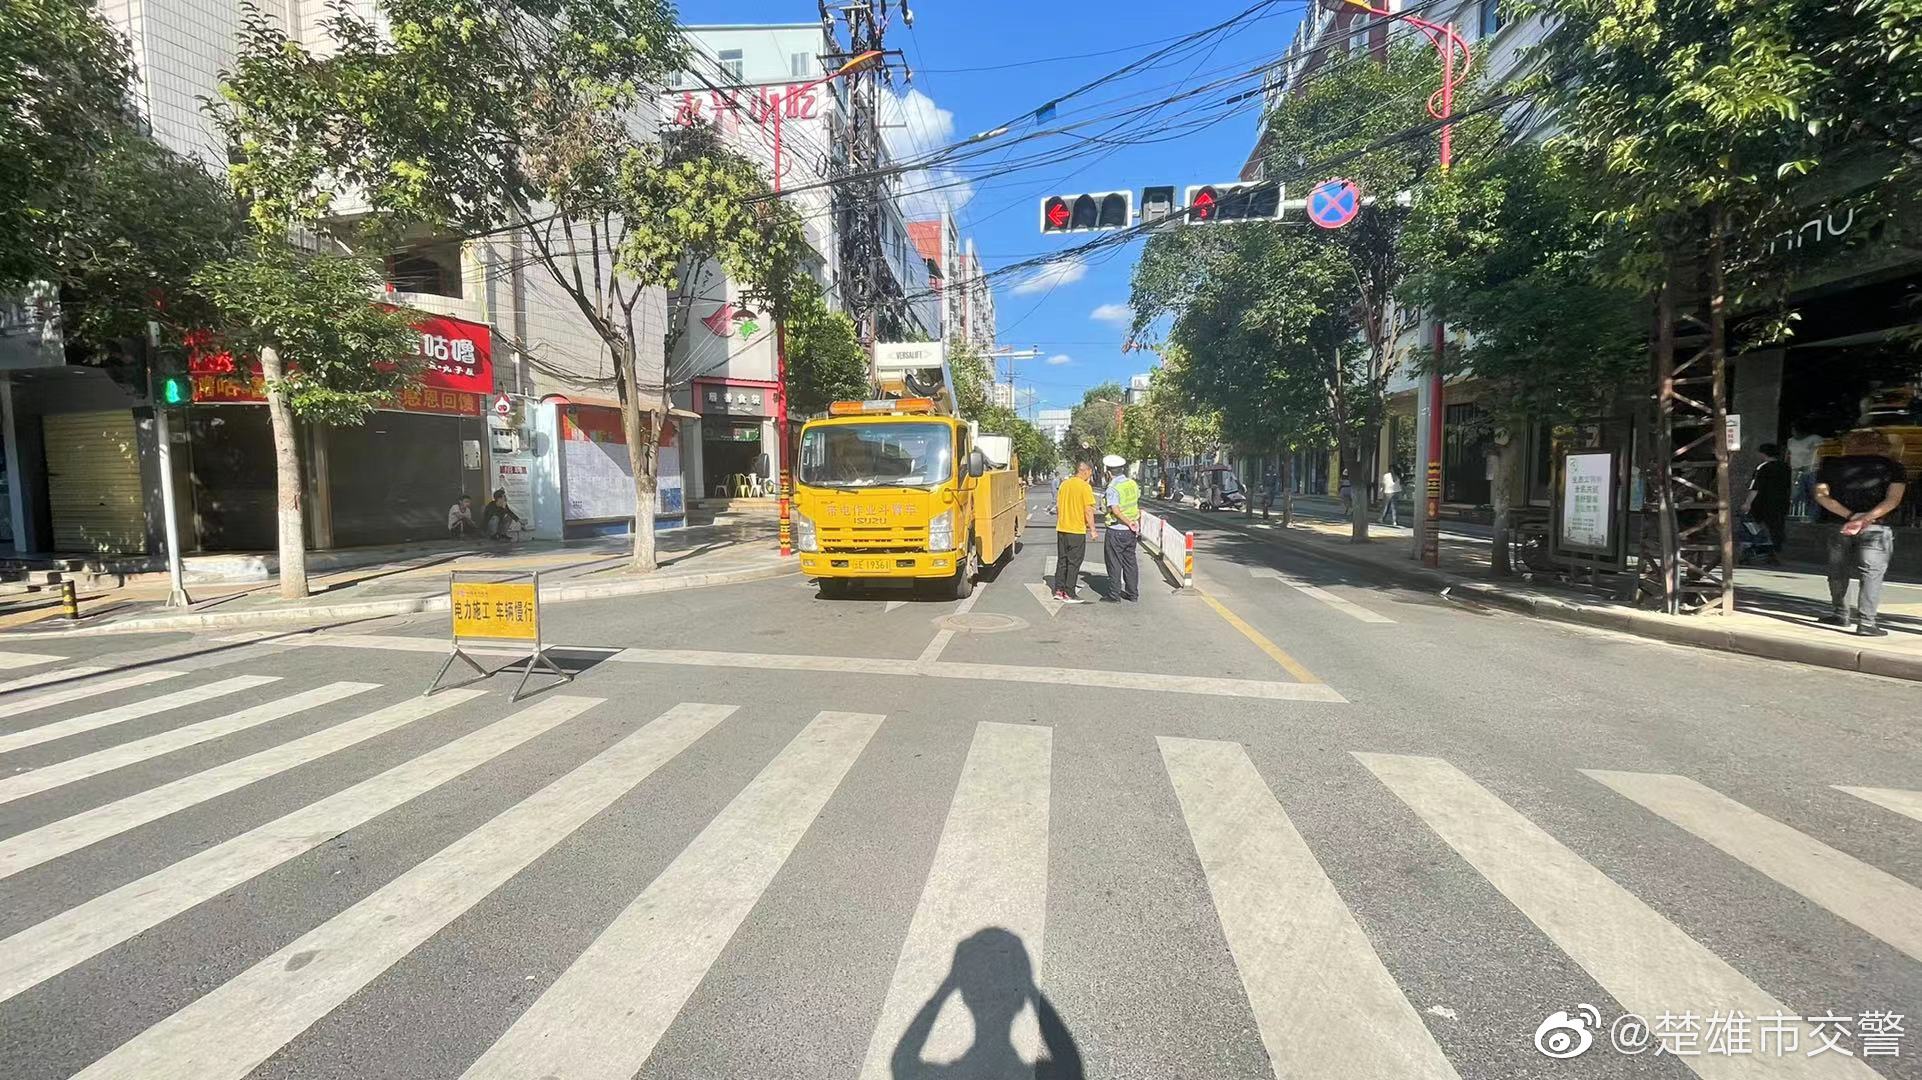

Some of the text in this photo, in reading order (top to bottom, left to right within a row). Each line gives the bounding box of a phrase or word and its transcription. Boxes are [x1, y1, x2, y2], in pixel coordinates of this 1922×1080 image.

[408, 333, 476, 365] 咕噜
[896, 350, 923, 360] VERSALIFT
[853, 517, 888, 525] ISUZU
[454, 600, 534, 623] 电力施工 车辆慢行
